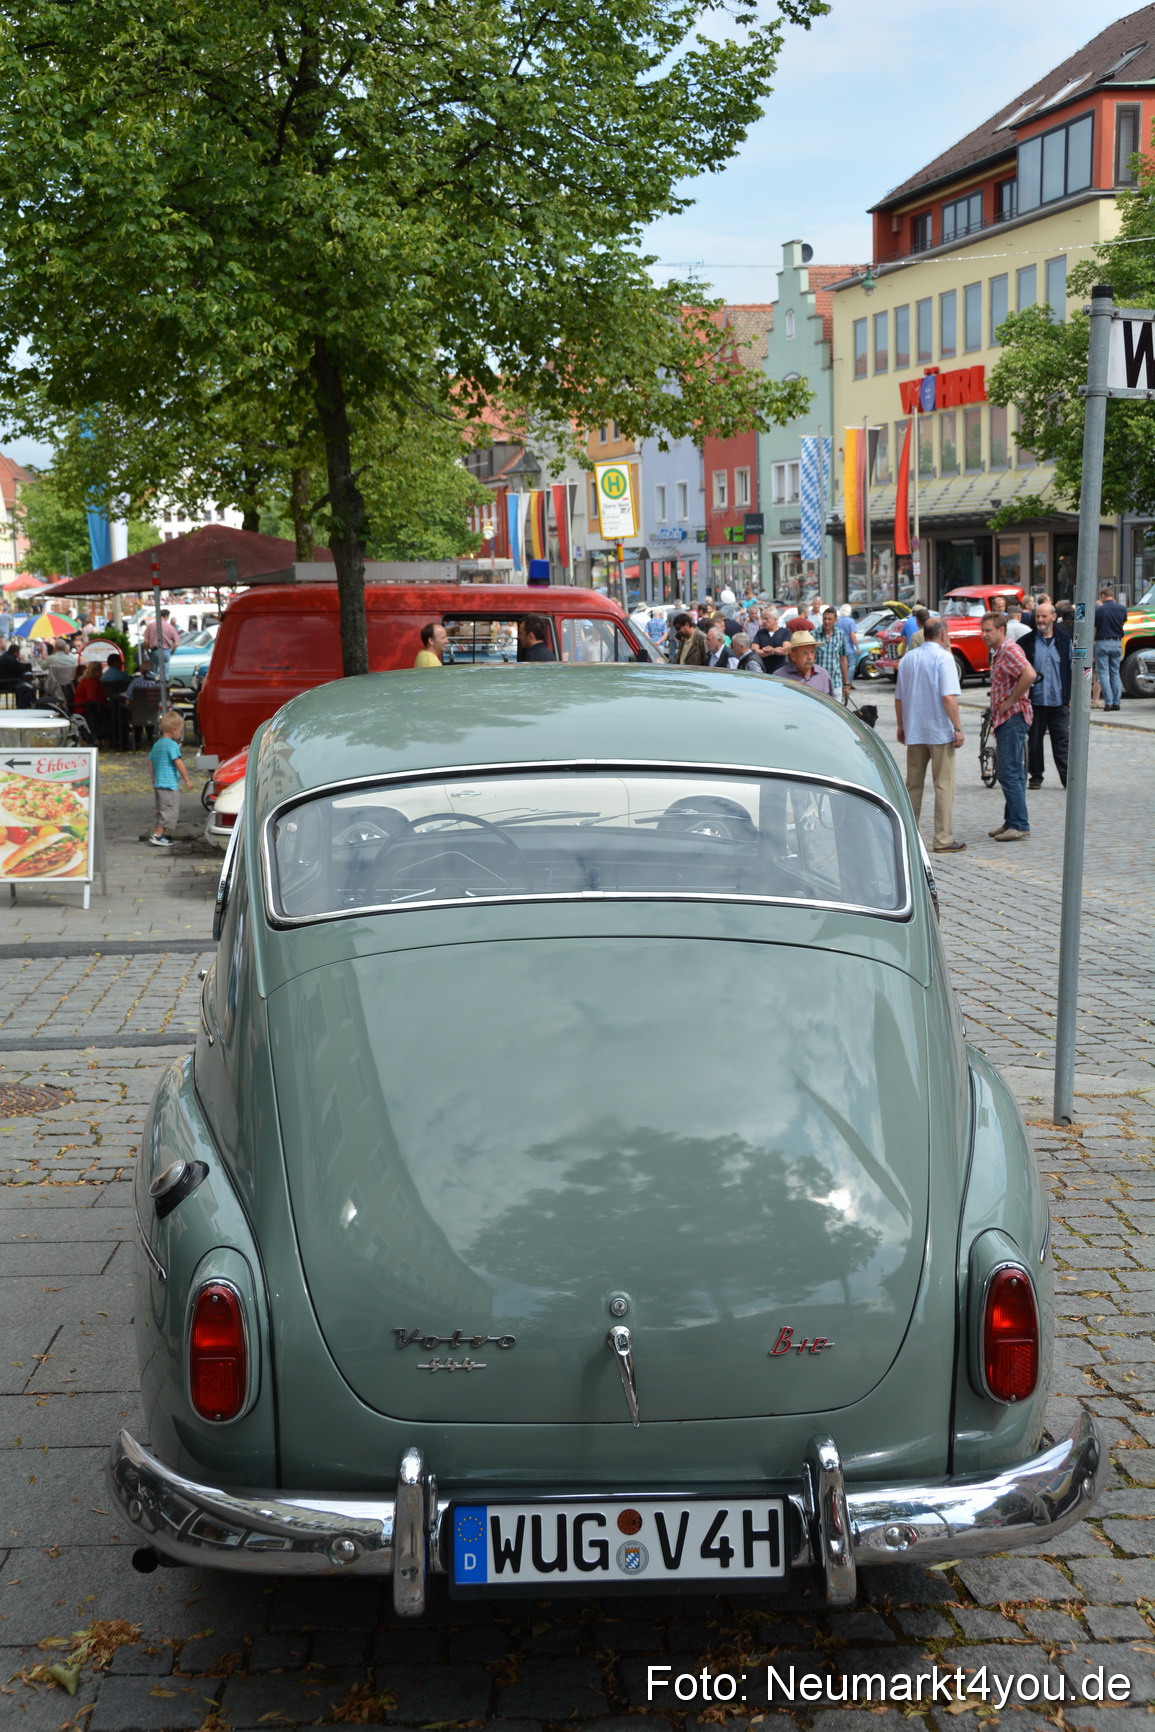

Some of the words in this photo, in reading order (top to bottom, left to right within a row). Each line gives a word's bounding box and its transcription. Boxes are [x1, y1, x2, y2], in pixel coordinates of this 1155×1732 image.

[899, 365, 988, 415] WÖHRL
[608, 475, 621, 492] H
[36, 756, 87, 774] Ekber's
[393, 1327, 517, 1349] Volvo
[422, 1357, 482, 1373] 544
[490, 1514, 609, 1574] WUG
[464, 1552, 478, 1571] D
